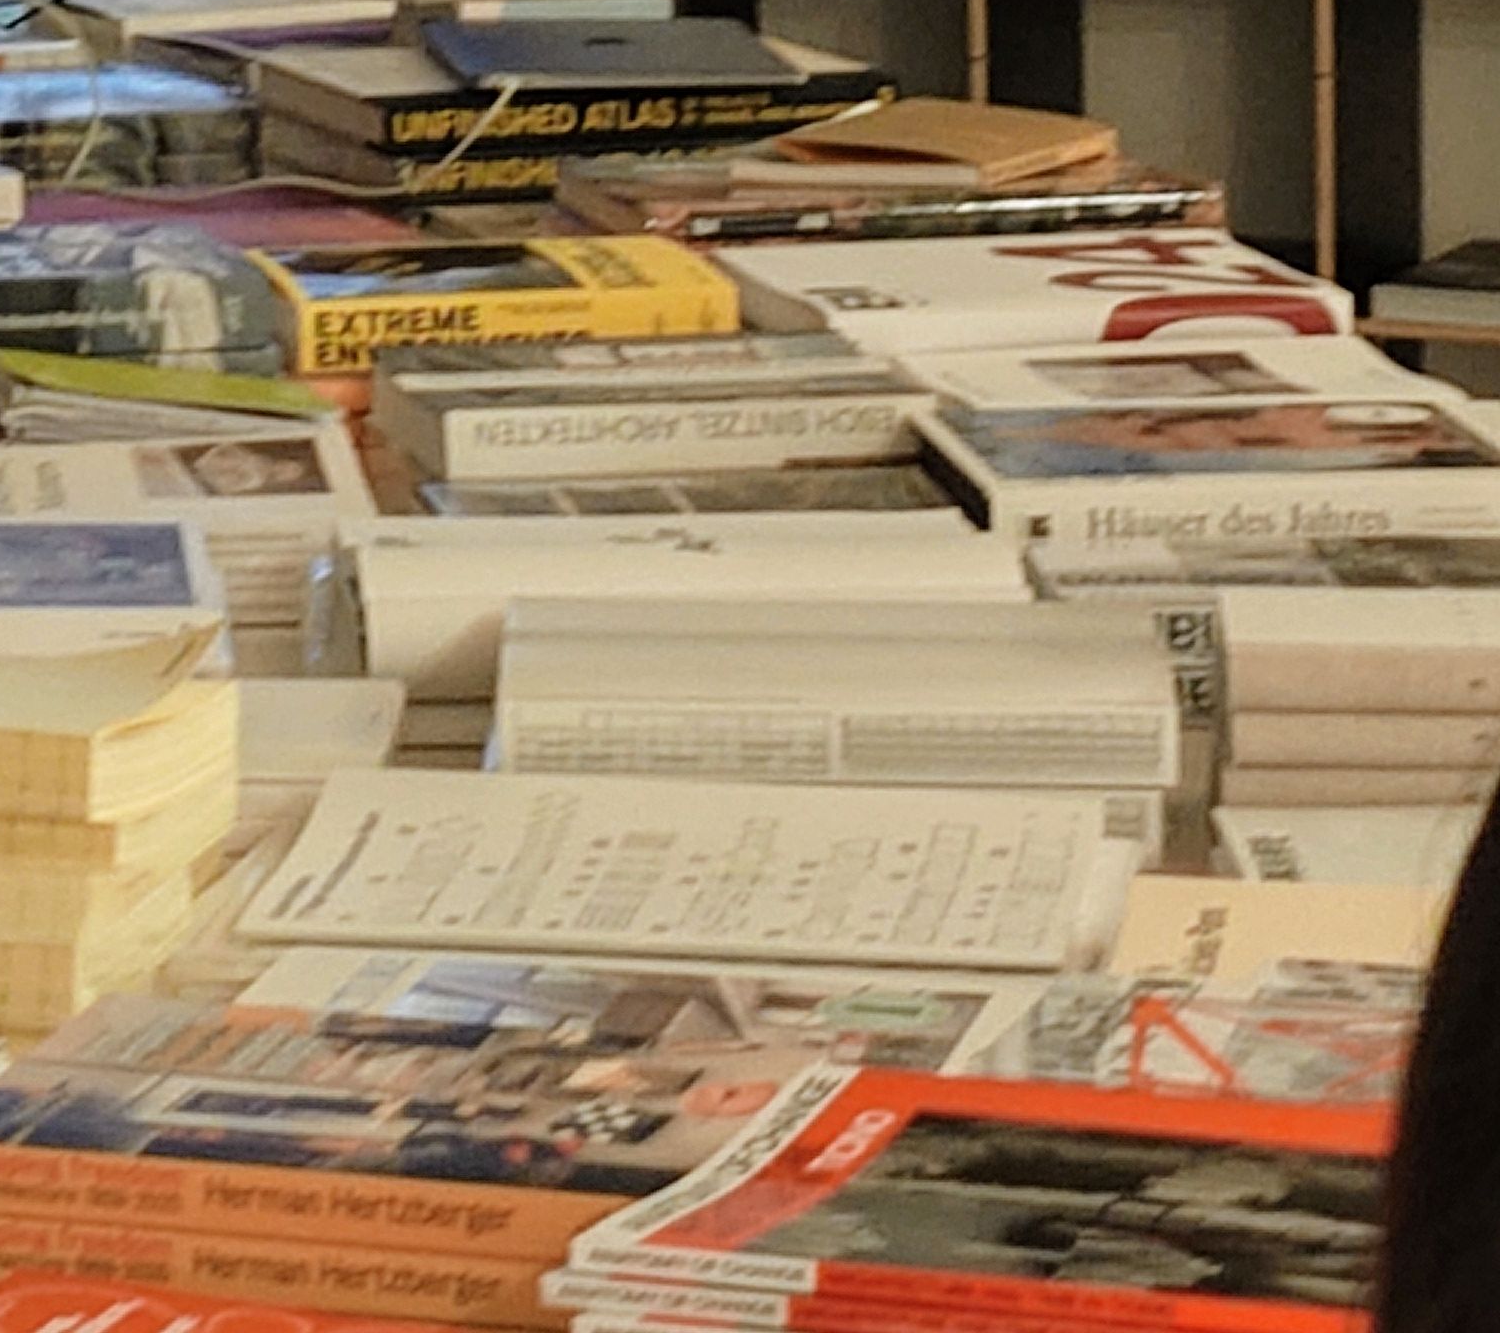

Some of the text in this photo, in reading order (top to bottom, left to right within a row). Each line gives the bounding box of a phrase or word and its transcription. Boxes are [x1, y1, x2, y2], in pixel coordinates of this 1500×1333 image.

[313, 304, 481, 337] EXTREME
[1219, 503, 1274, 534] des
[202, 1174, 322, 1217] Herman
[330, 1185, 515, 1238] Hertzberger
